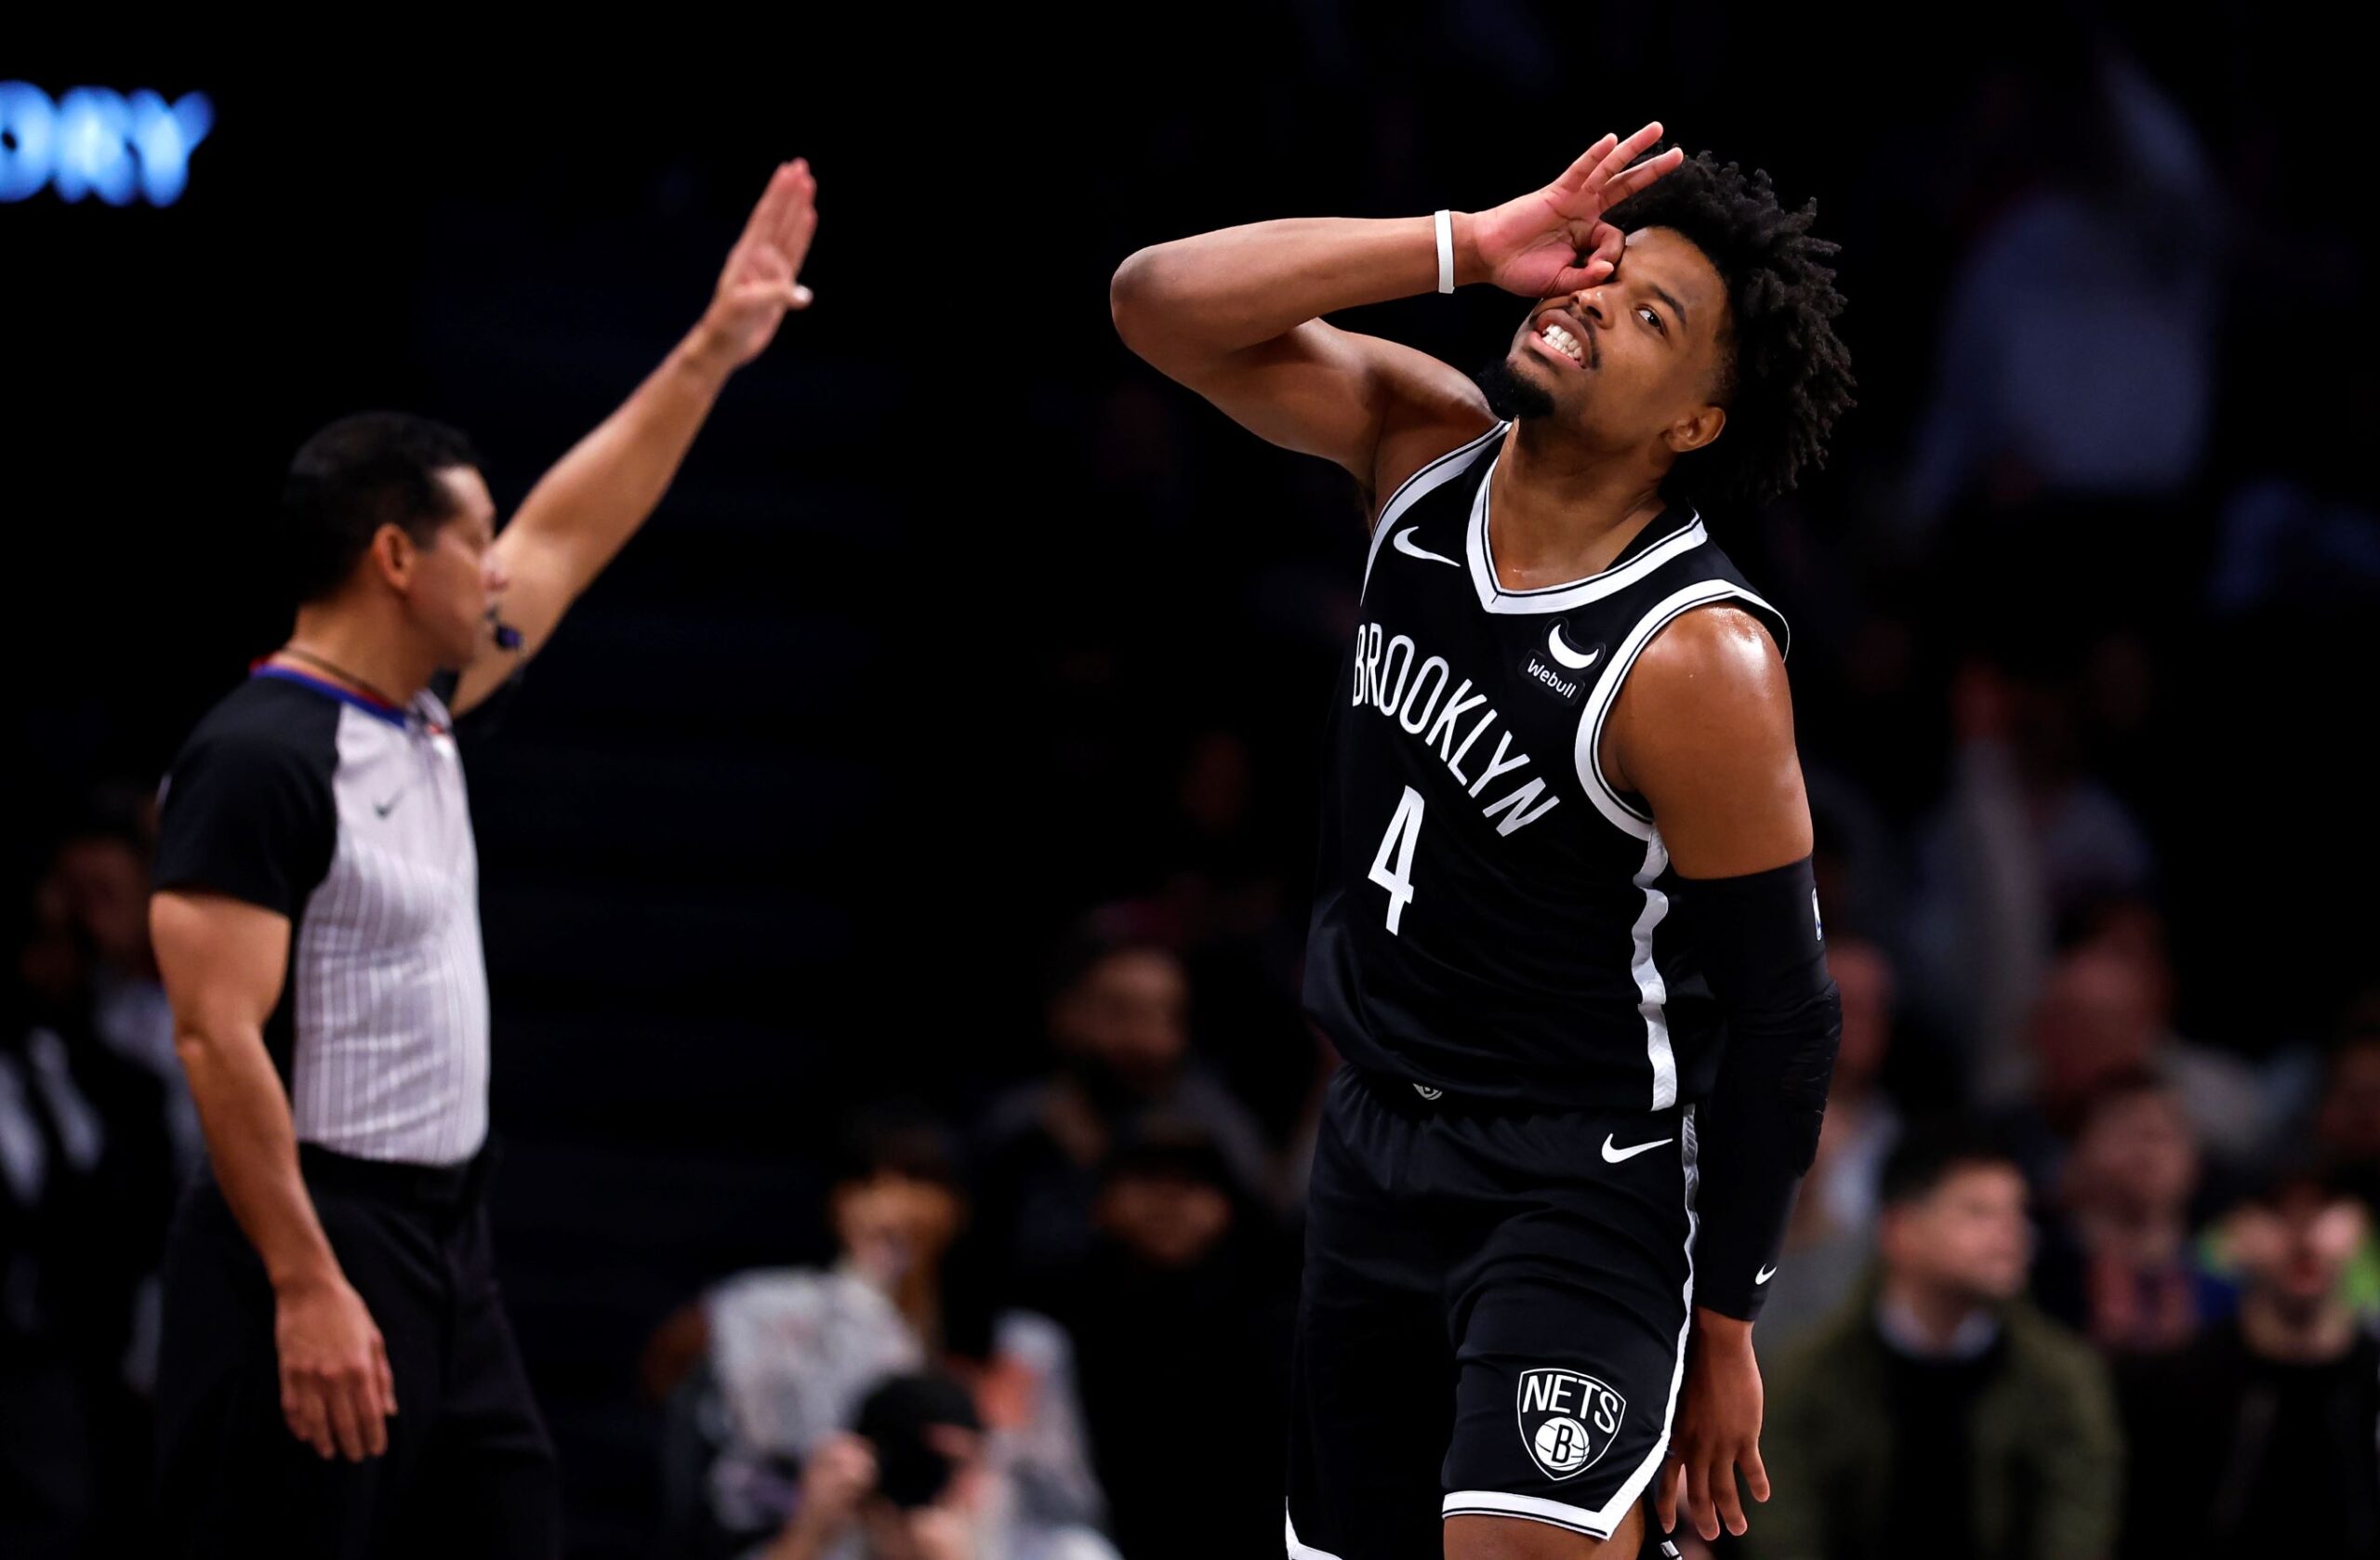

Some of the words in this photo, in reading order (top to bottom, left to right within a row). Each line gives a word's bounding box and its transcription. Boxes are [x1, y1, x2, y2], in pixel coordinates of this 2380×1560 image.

[1527, 657, 1577, 699] Webull
[1353, 622, 1560, 837] BROOKLYN
[1368, 785, 1425, 936] 4
[1522, 1373, 1619, 1434] NETS
[1551, 1423, 1574, 1464] B
